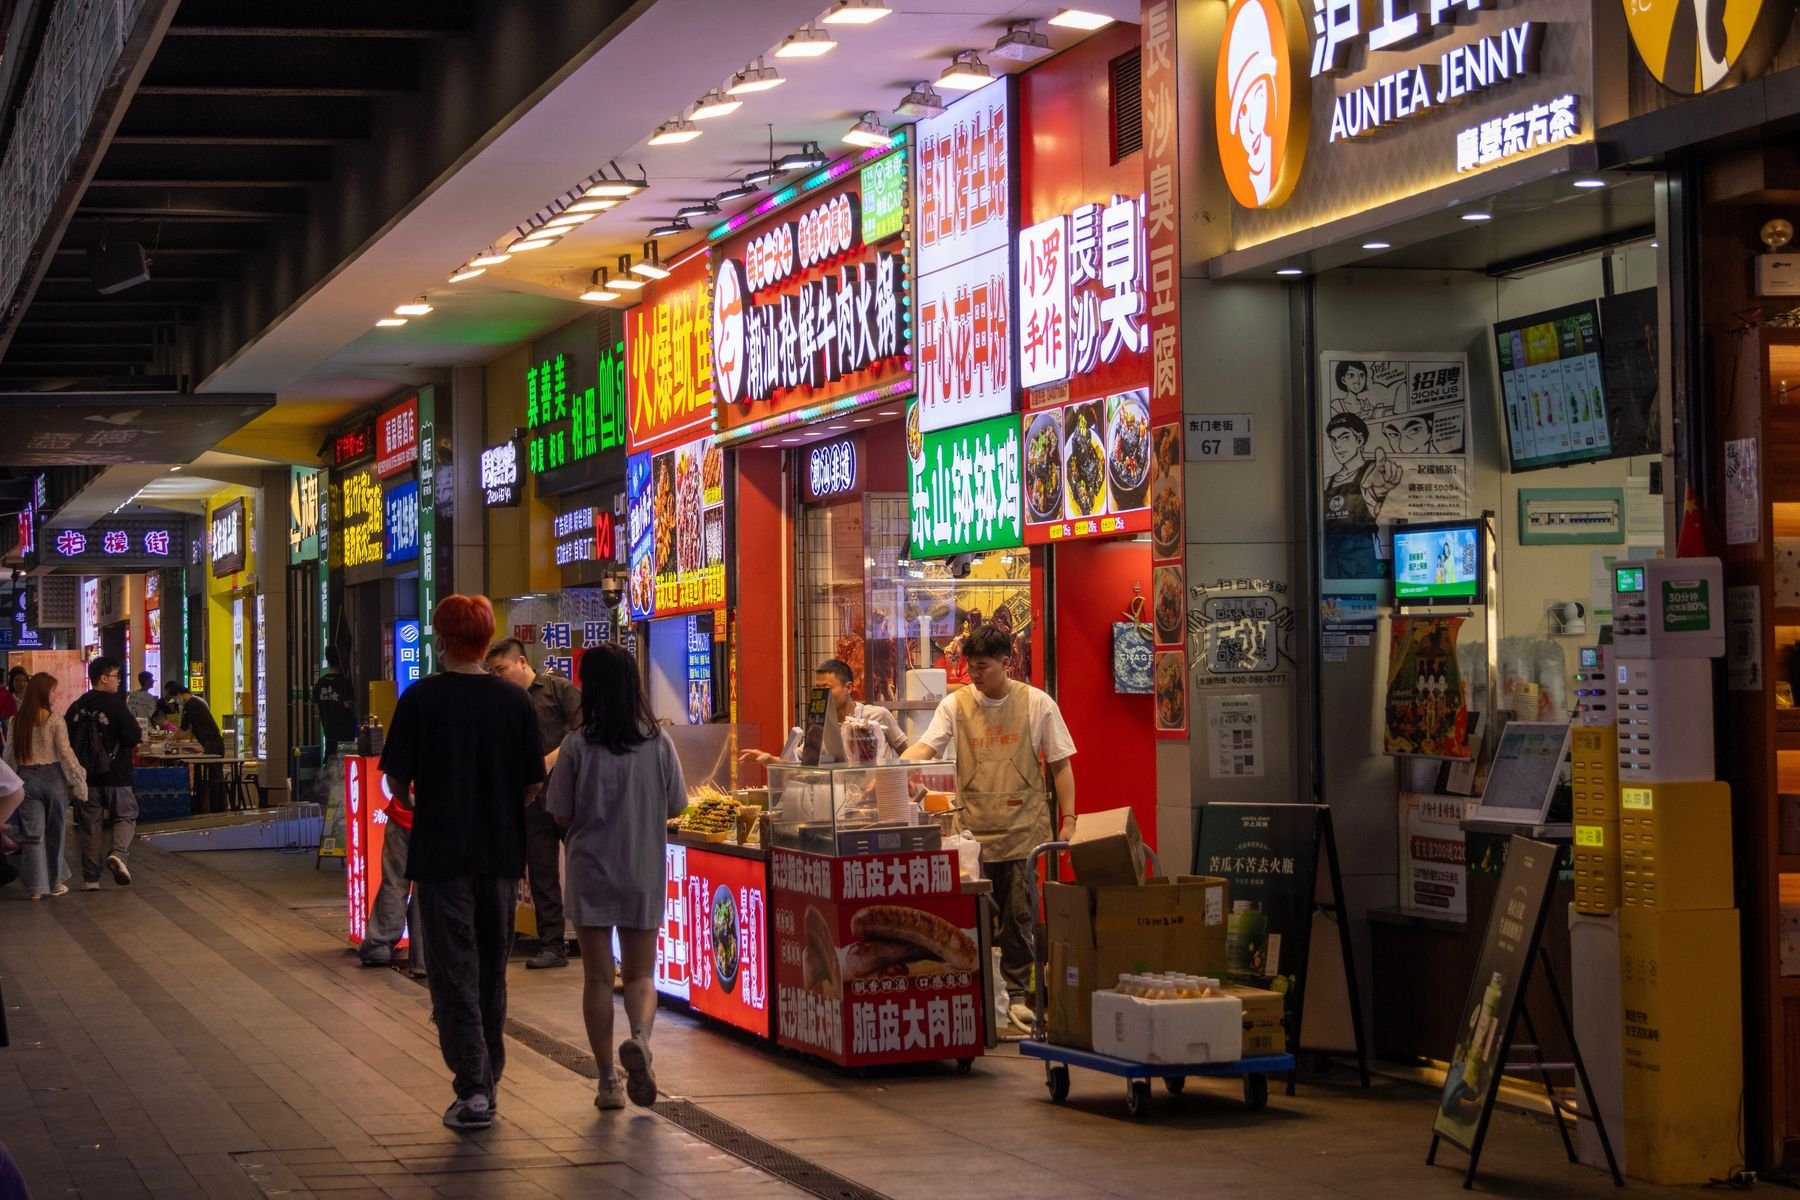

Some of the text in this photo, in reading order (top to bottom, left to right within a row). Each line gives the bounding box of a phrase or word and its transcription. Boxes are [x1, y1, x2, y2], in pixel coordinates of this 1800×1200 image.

[1310, 0, 1481, 77] 沪上
[1329, 22, 1529, 143] AUNTEA JENNY
[1457, 95, 1577, 172] 摩登东方茶
[1146, 5, 1177, 400] 長沙臭豆腐
[919, 273, 1008, 412] 开心花甲粉
[1412, 366, 1460, 392] 招聘
[527, 353, 567, 429] 真善美
[571, 387, 598, 462] 相照
[1189, 419, 1233, 433] 东门老街
[1411, 385, 1458, 400] JION US
[1201, 439, 1222, 455] 67
[911, 427, 1021, 550] 乐山钵钵鸡
[57, 530, 170, 556] 柠檬街
[843, 855, 953, 899] 脆皮大肉肠
[1208, 855, 1294, 875] 苦瓜不苦去火瓶
[702, 877, 712, 991] 老长沙
[740, 886, 751, 1006] 臭豆腐
[853, 995, 976, 1055] 脆皮大肉肠
